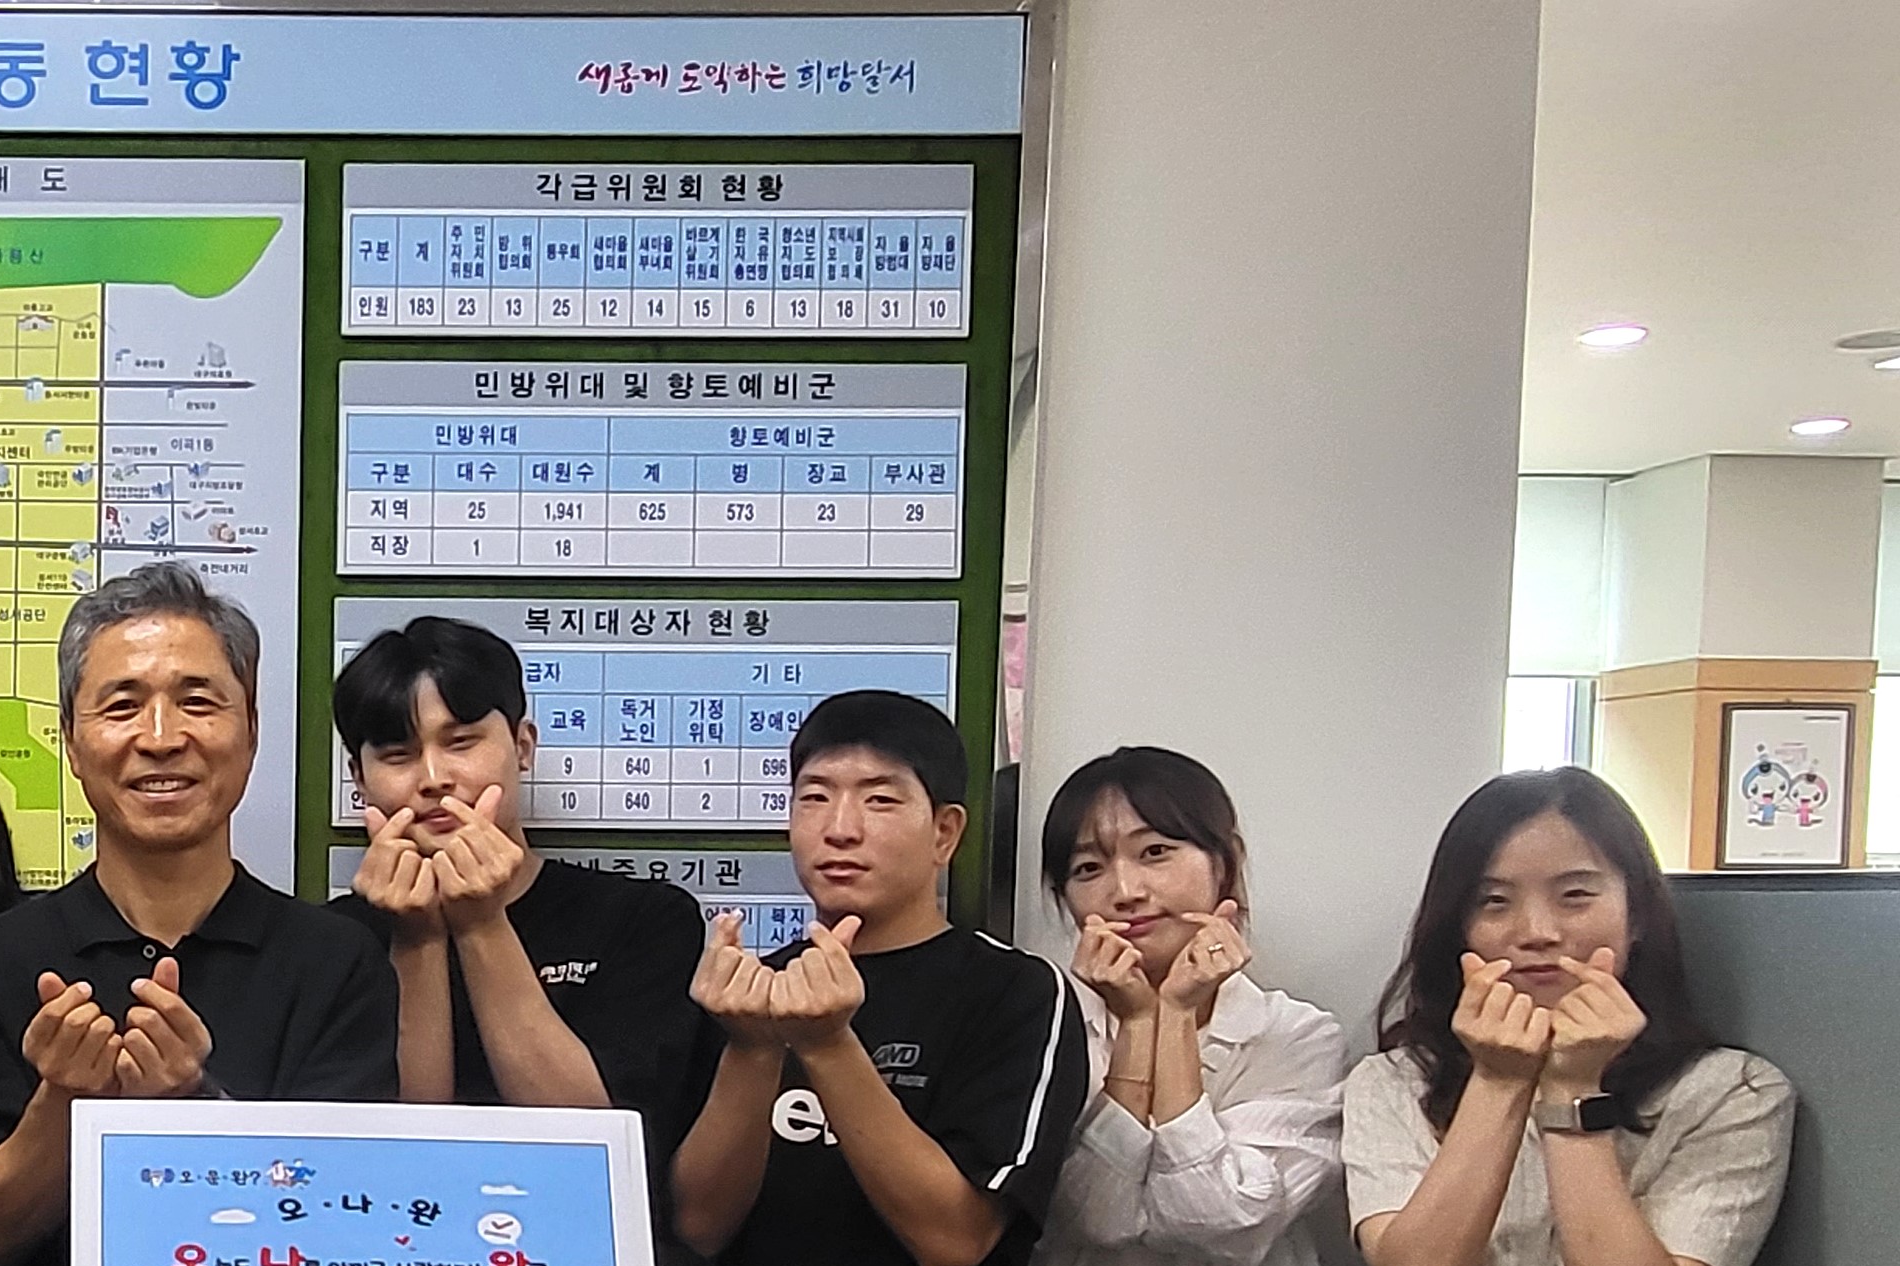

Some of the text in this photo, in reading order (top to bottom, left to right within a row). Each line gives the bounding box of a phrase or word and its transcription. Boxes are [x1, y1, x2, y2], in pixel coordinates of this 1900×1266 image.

[86, 38, 242, 110] 현황
[577, 61, 668, 95] 새롭게
[797, 60, 916, 96] 희망달서
[359, 296, 946, 318] 인원 183 23 13 25 12 14 15 13 31 10
[474, 372, 837, 400] 민방위대 및 향토예비군
[370, 499, 925, 522] 지역 25 1,941 625 573 23 29
[370, 535, 410, 555] 직장
[525, 609, 771, 637] 복지대상자 현황
[550, 709, 587, 731] 교육
[620, 699, 657, 719] 독거
[689, 699, 725, 720] 가정
[620, 722, 725, 743] 노인 위탁
[625, 757, 787, 778] 640 696
[560, 791, 786, 812] 10 640 739
